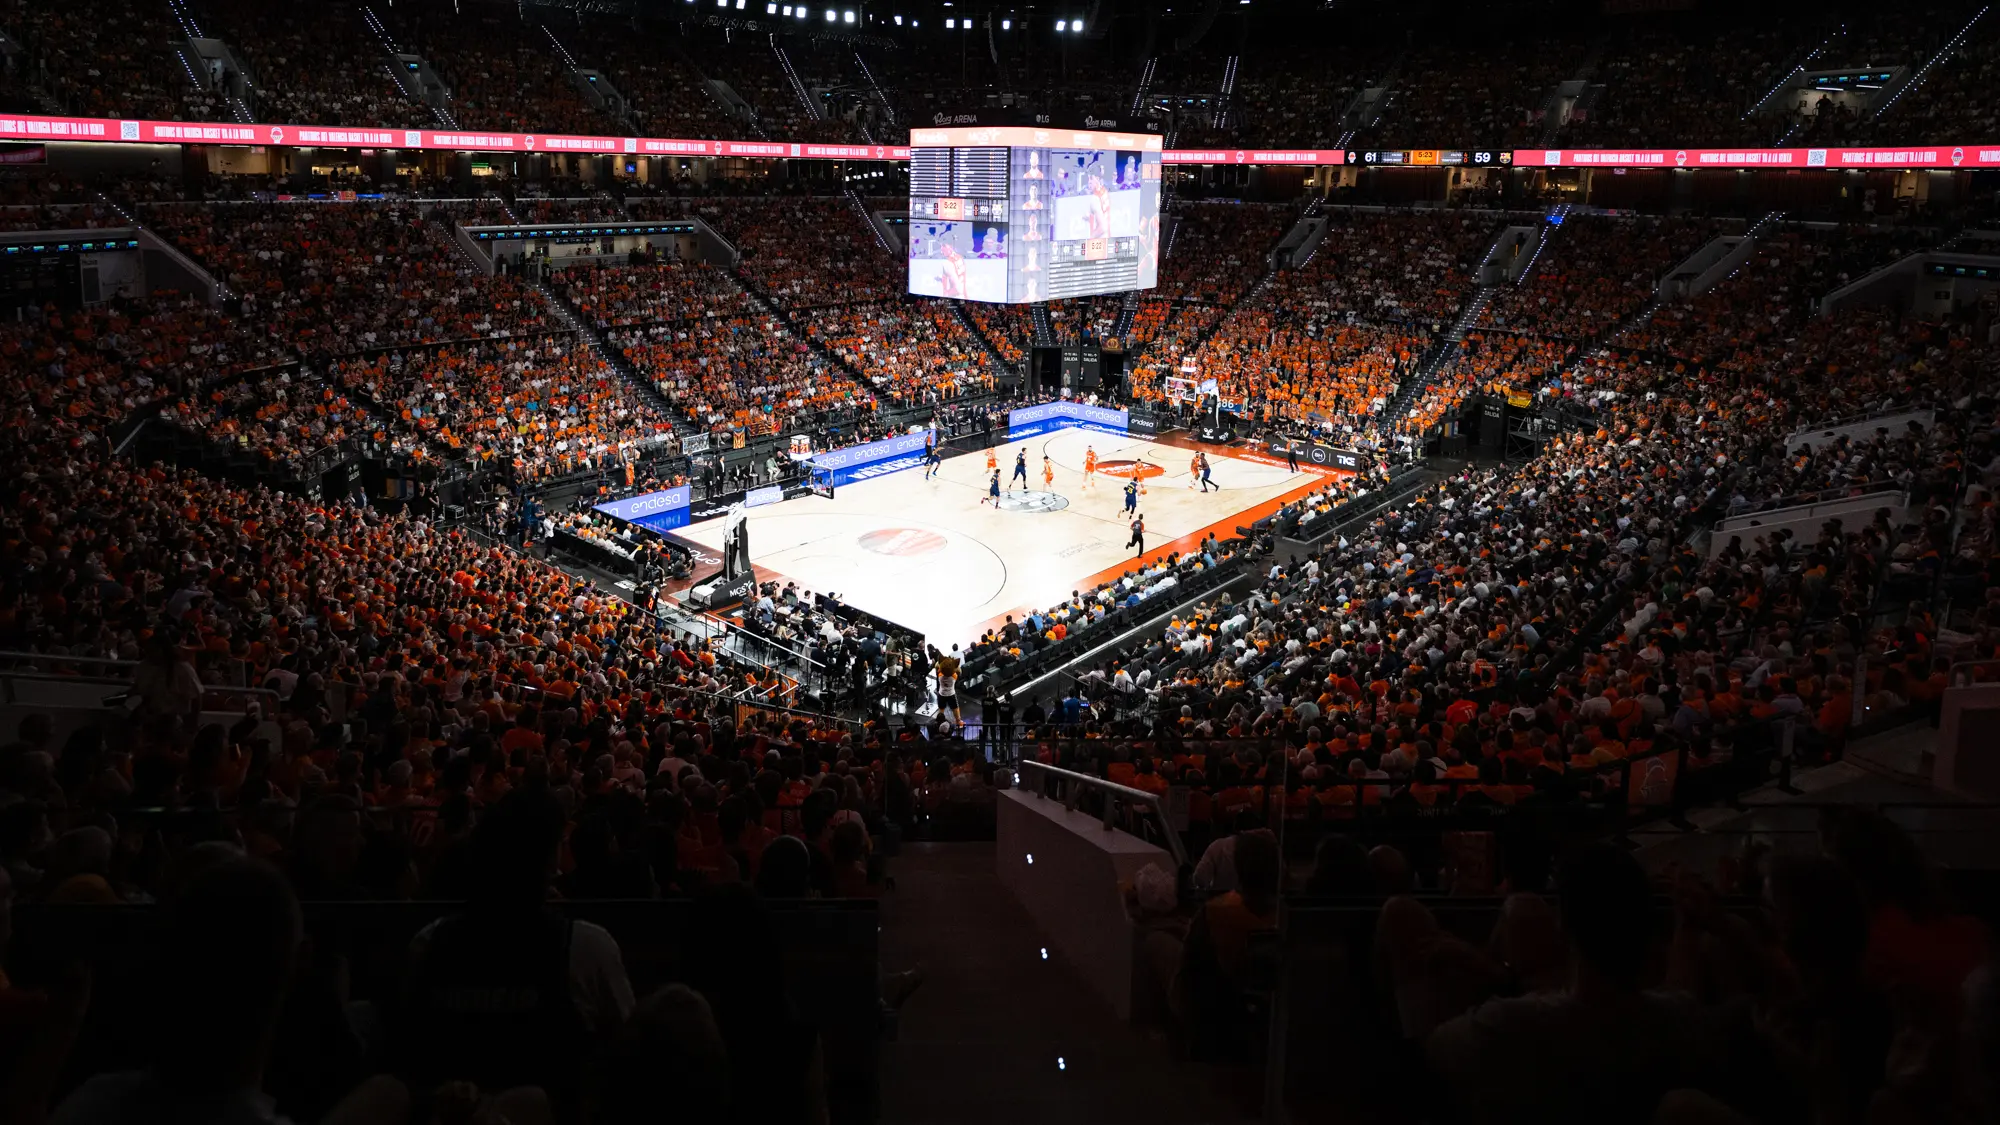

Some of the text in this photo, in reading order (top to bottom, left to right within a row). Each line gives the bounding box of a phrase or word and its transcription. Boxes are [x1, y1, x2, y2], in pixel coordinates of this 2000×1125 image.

[953, 114, 978, 124] ARENA
[1100, 119, 1117, 128] ARENA
[1364, 152, 1376, 162] 61
[1475, 152, 1491, 162] 59
[1015, 409, 1043, 422] endesa
[1048, 405, 1078, 416] endesa
[1086, 410, 1121, 423] endesa
[1131, 418, 1154, 428] endesa
[791, 444, 799, 453] 21
[800, 444, 809, 453] 21
[854, 444, 890, 460] endesa
[814, 454, 847, 467] ndesa
[1336, 454, 1356, 466] TKE
[631, 493, 680, 513] endesa
[730, 586, 746, 597] MGS
